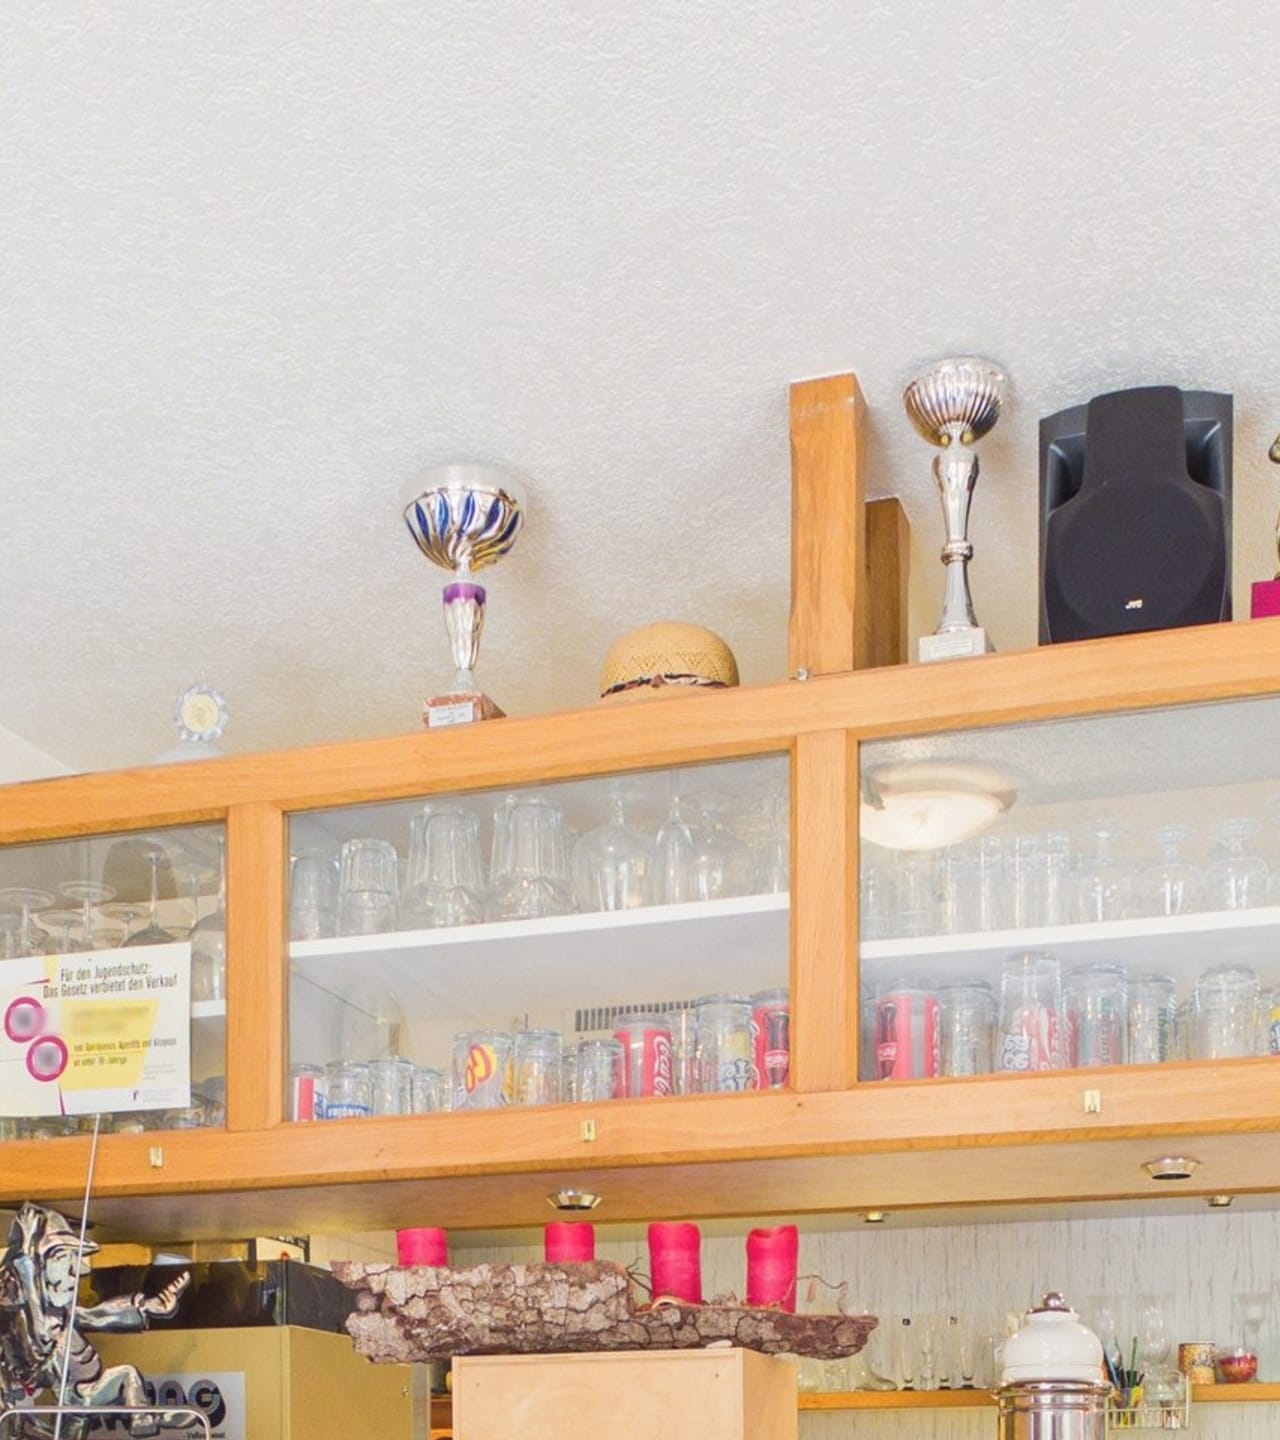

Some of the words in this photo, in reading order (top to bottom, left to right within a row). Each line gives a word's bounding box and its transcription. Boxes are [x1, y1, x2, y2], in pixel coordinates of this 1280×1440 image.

[77, 967, 91, 981] den
[43, 985, 58, 999] Das
[61, 982, 88, 997] Gesetz
[90, 978, 126, 994] verbietet
[128, 976, 144, 991] den
[146, 972, 178, 989] Verkauf
